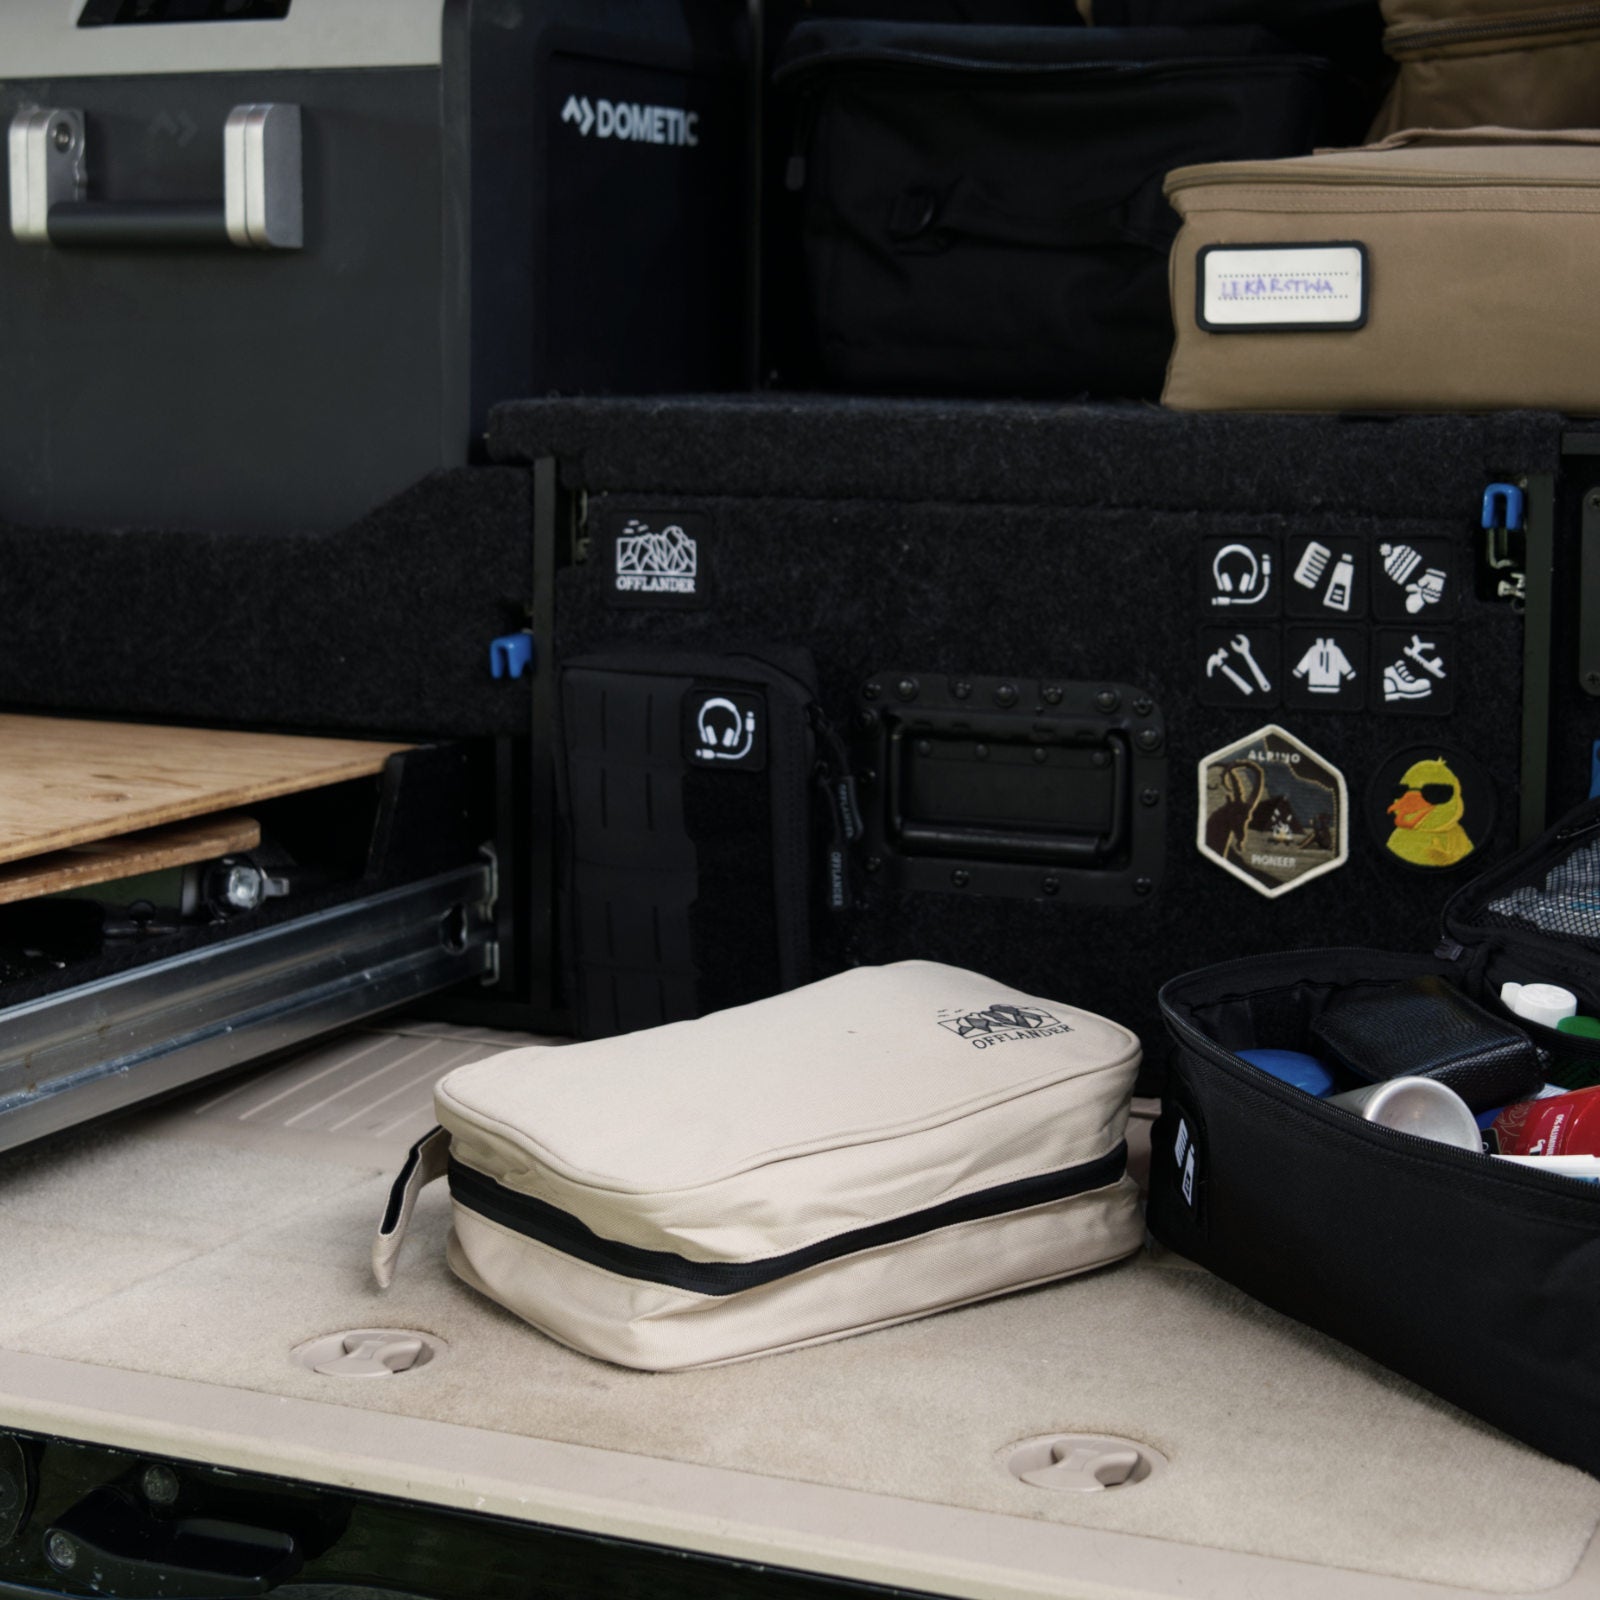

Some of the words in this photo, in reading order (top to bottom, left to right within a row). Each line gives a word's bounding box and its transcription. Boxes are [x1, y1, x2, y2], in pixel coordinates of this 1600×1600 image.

[596, 99, 699, 147] DOMETIC
[1221, 277, 1334, 300] LEKARSTWA
[616, 576, 696, 593] OFFLANDER
[1251, 854, 1297, 867] PIONEER
[972, 1023, 1075, 1049] OFFLANDER
